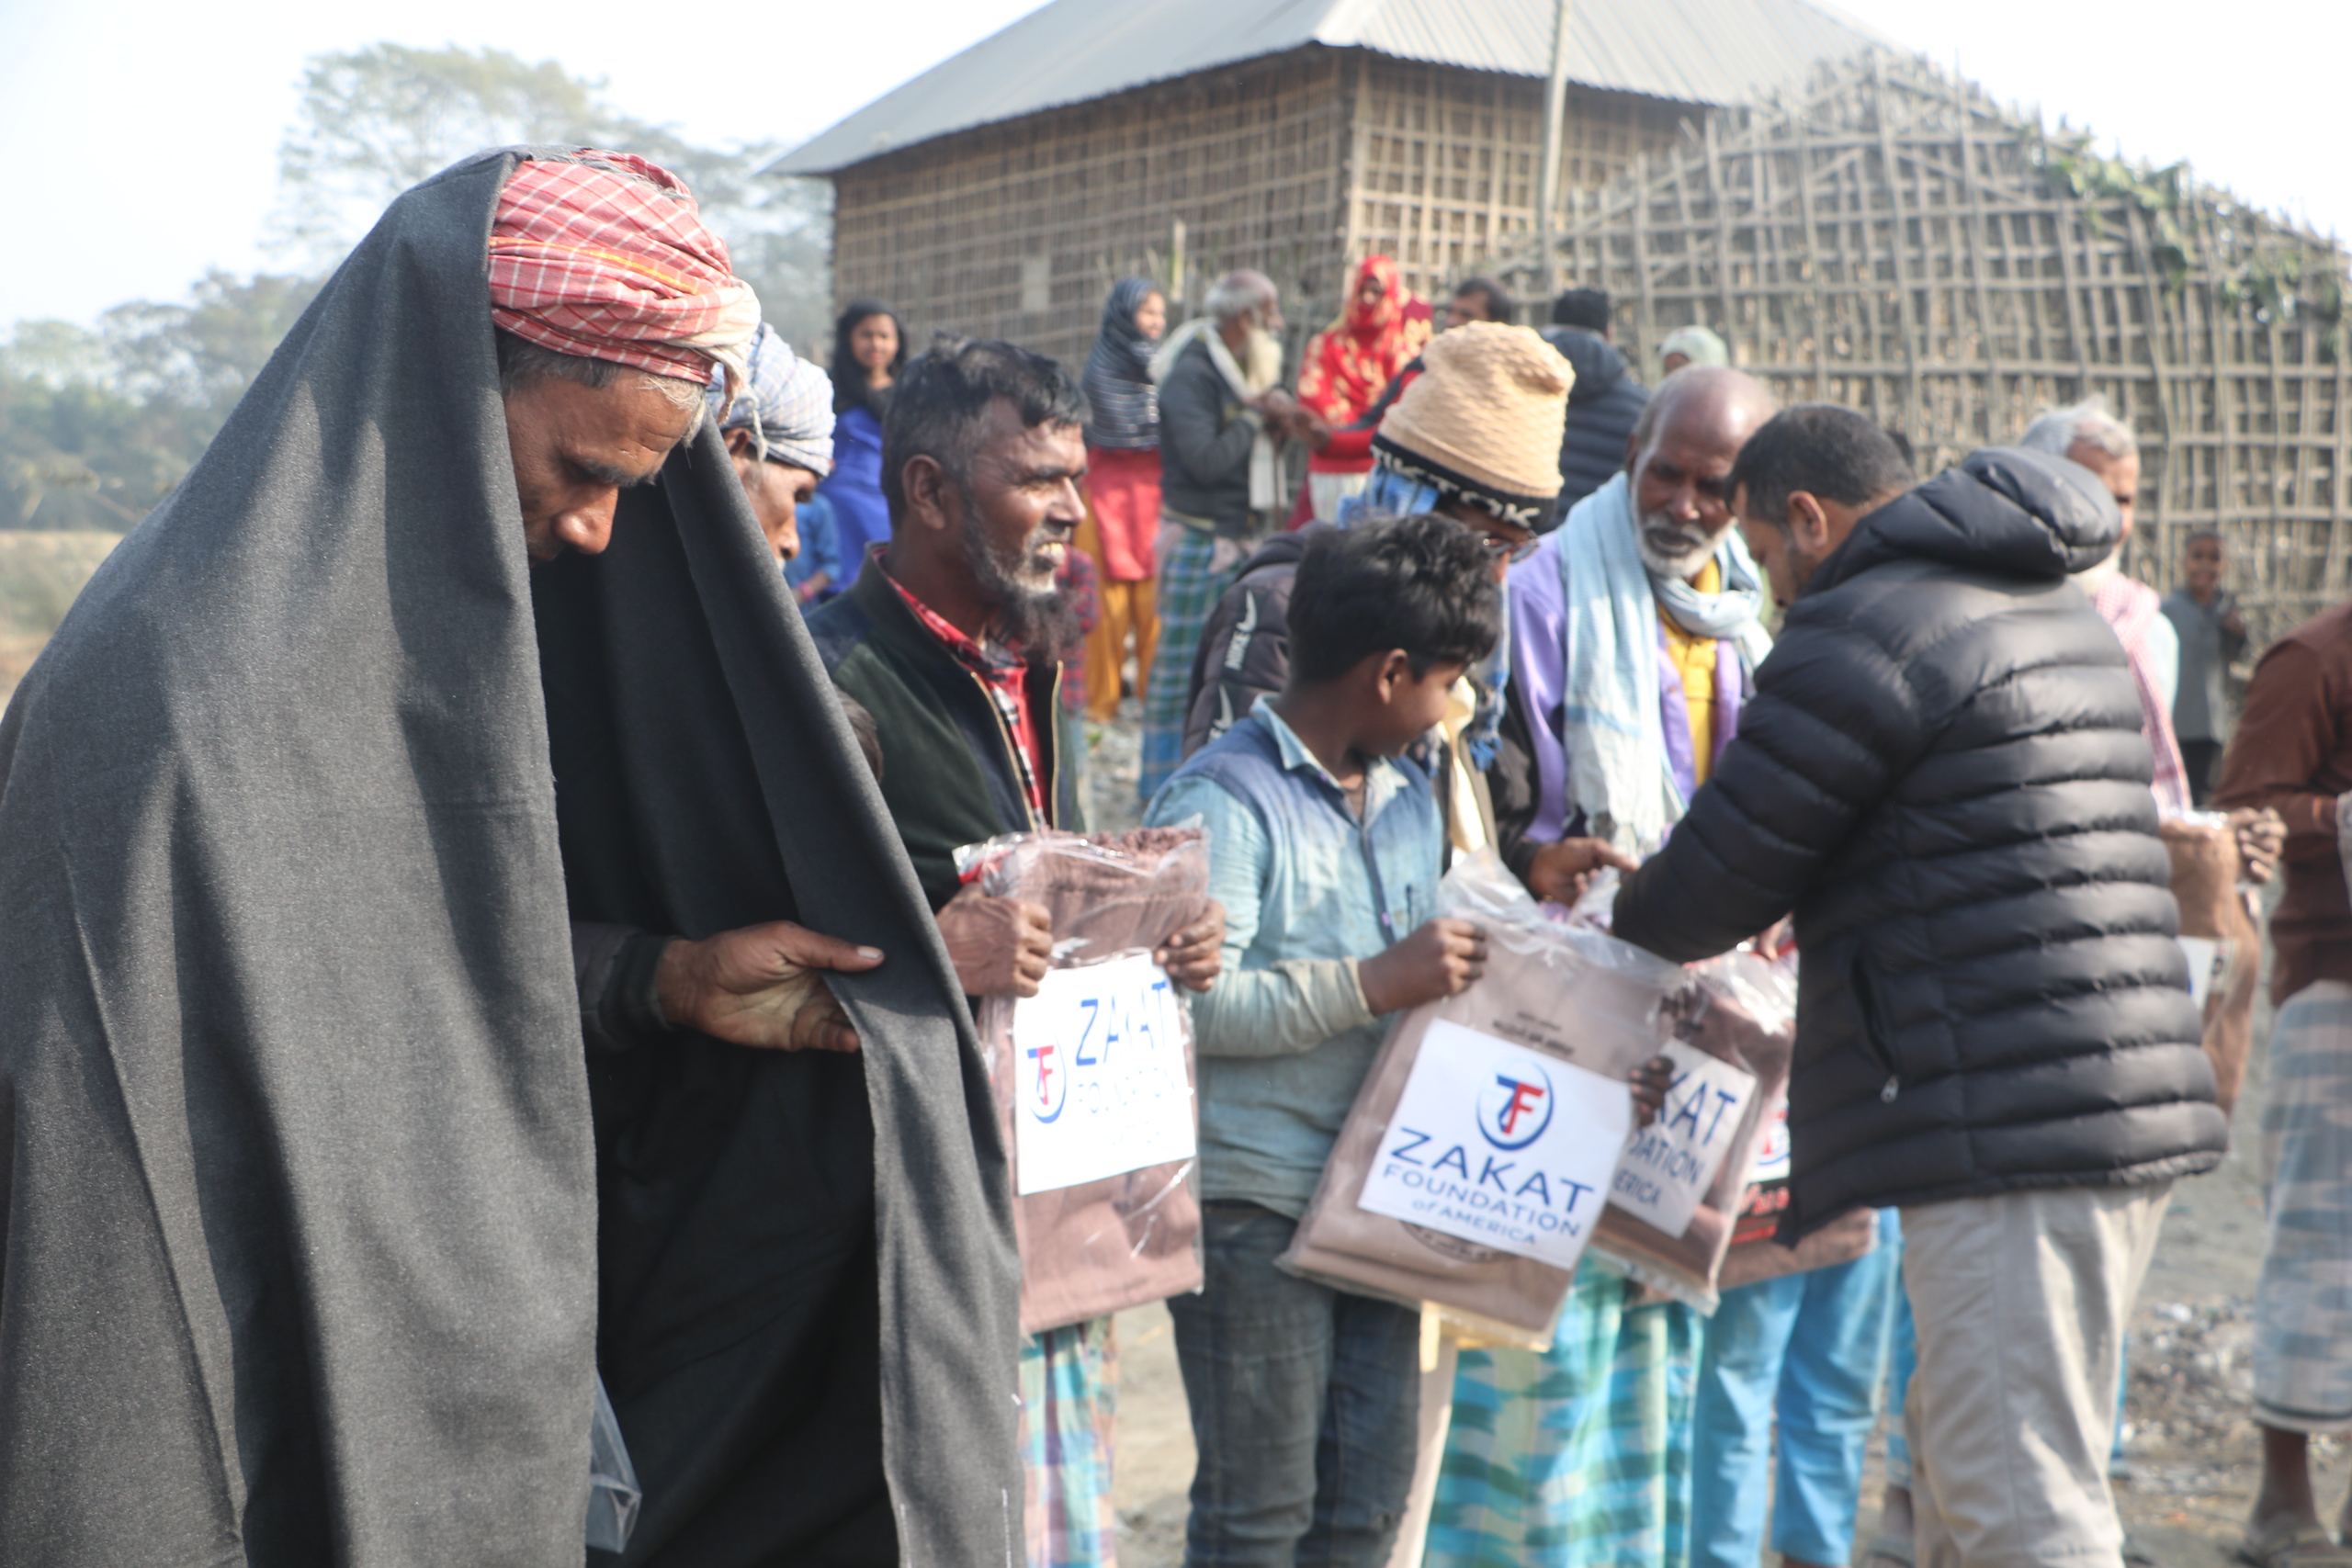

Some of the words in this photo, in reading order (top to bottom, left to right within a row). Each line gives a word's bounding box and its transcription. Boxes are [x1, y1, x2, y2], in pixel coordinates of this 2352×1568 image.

[1382, 1162, 1583, 1238] FOUNDATION
[1389, 1126, 1596, 1214] ZAKAT
[1439, 1204, 1537, 1246] AMERICA
